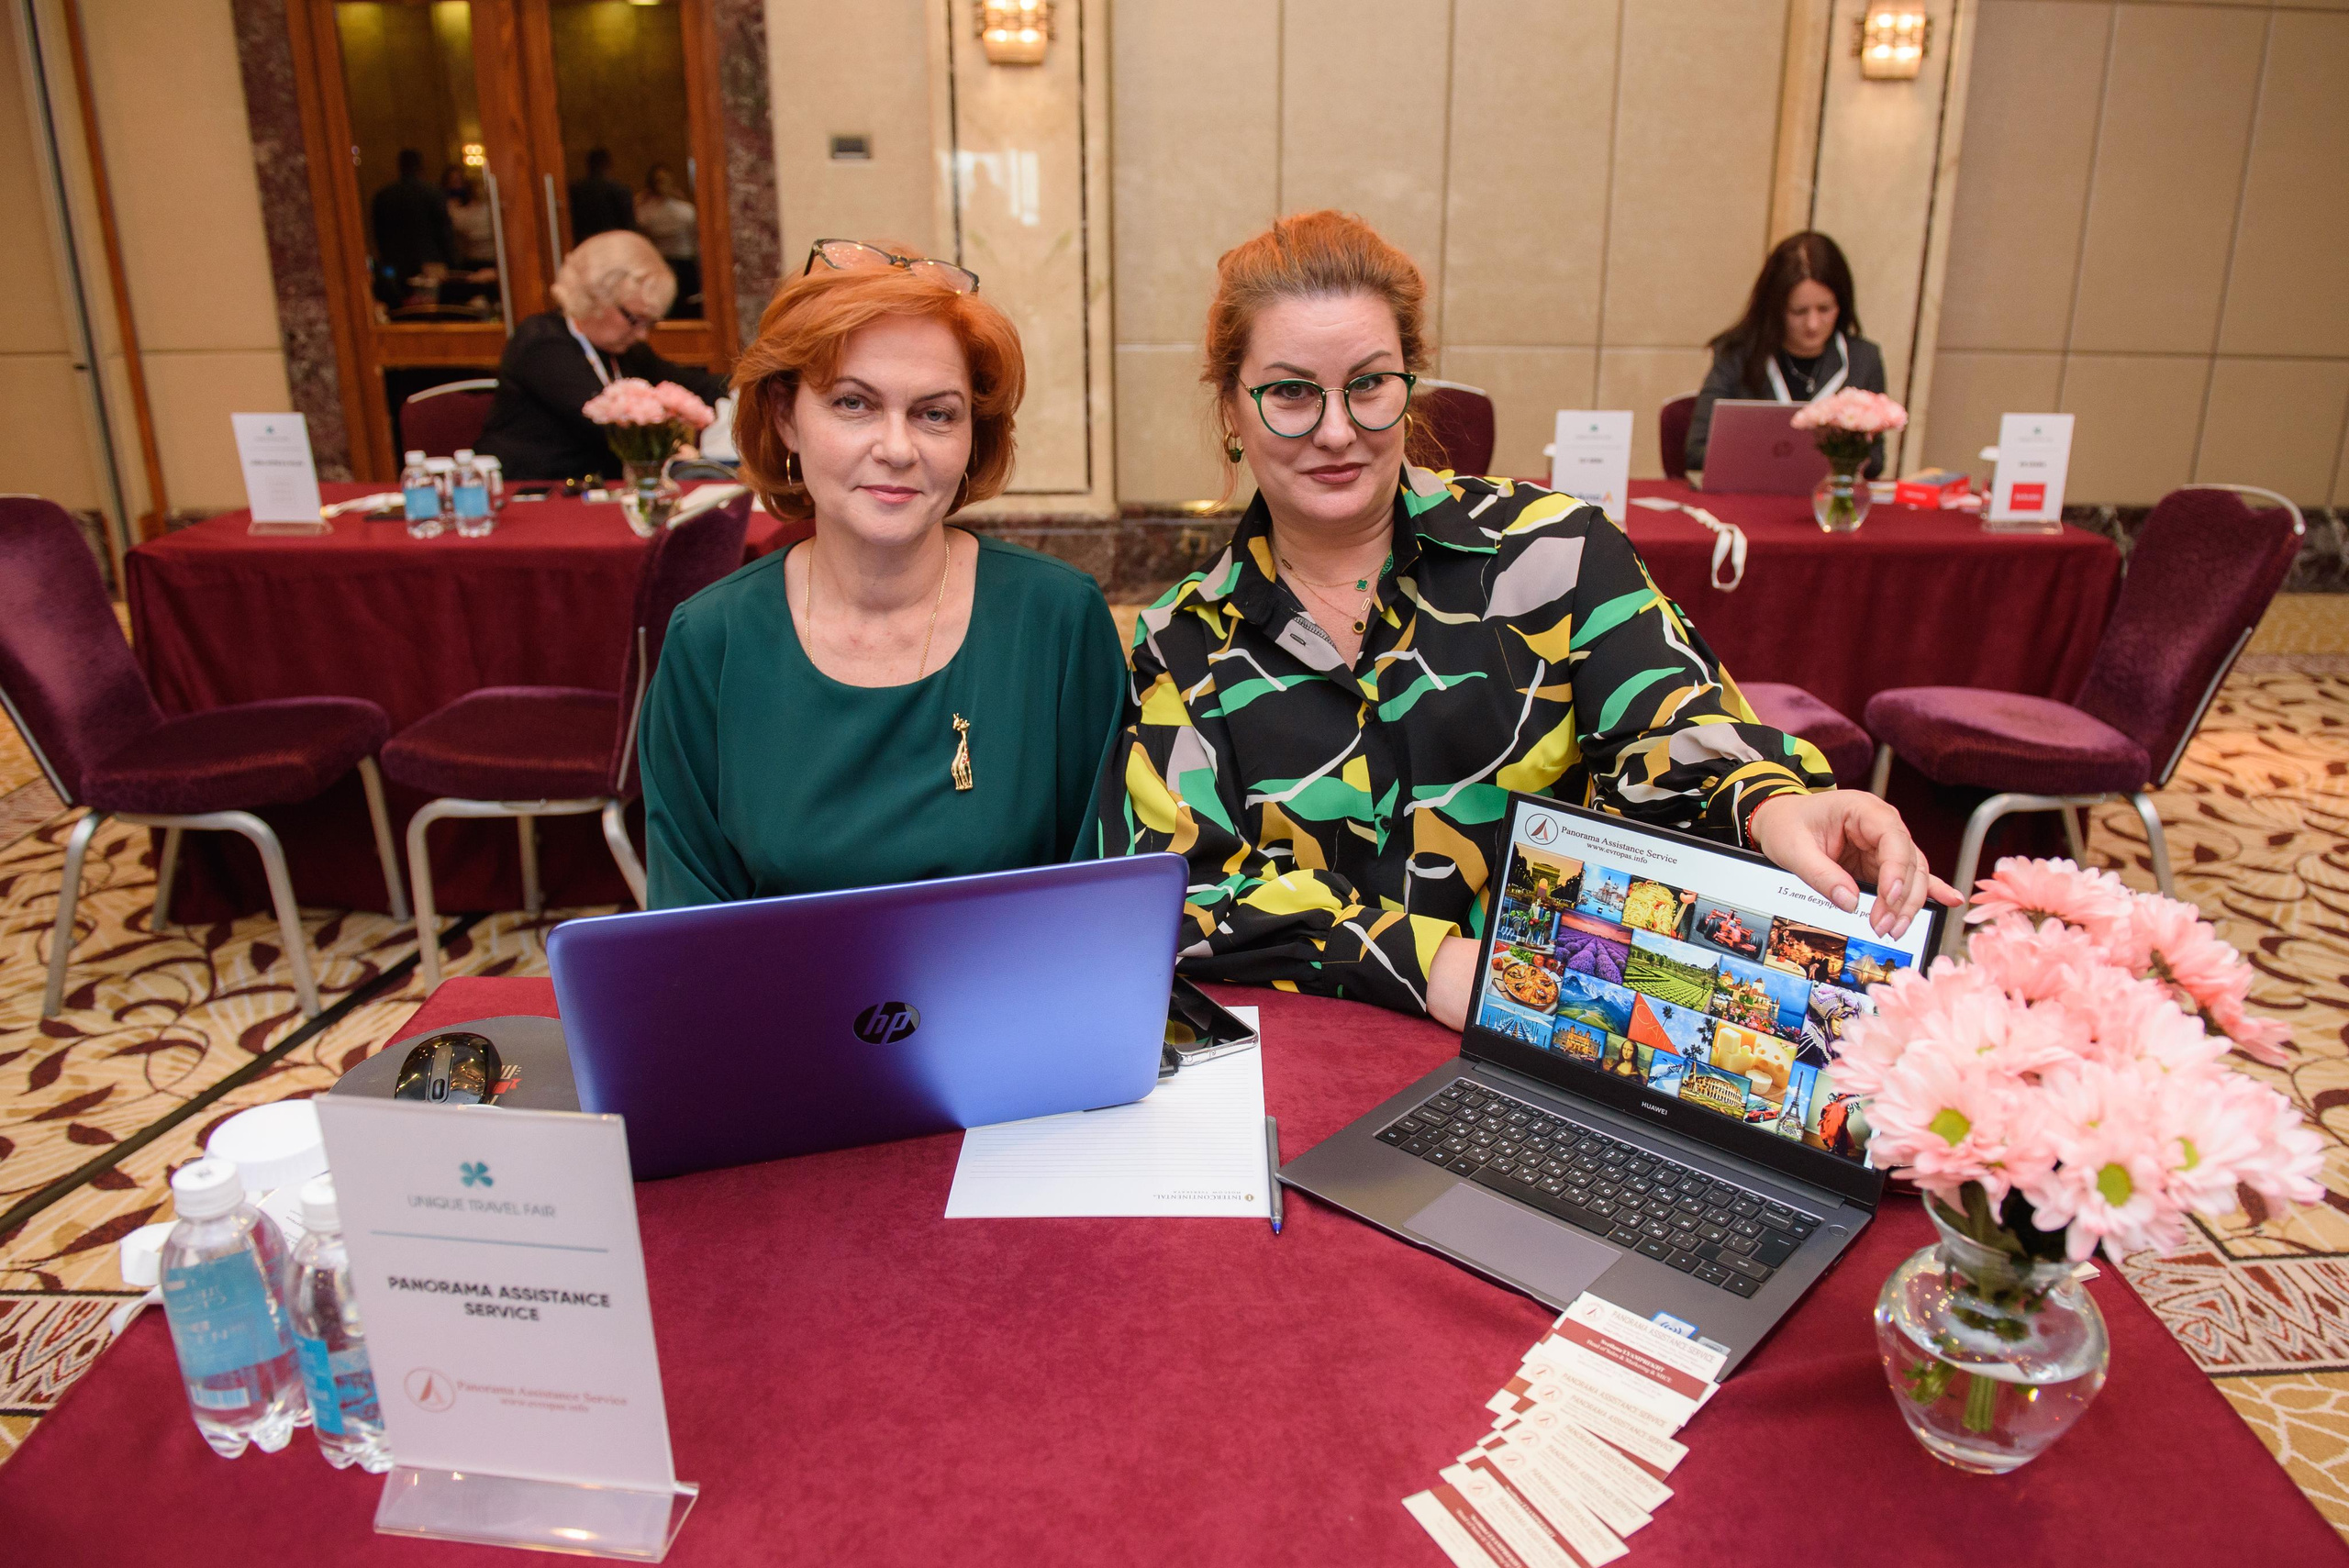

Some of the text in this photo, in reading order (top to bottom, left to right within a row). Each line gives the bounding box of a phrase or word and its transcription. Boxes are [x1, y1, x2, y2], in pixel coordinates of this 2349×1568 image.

[1561, 826, 1678, 864] Panorama Assistance Service
[1586, 842, 1648, 864] www.evropas.info
[1777, 886, 1789, 895] 15
[1789, 893, 1807, 901] лет
[863, 1002, 912, 1044] hp
[1642, 1101, 1667, 1116] HUAWEI
[407, 1195, 556, 1218] UNIQUE TRAVEL FAIR
[387, 1275, 611, 1309] PANORAMA ASSISTANCE
[464, 1302, 540, 1321] SERVICE
[1611, 1310, 1648, 1331] PANORAMA
[1650, 1327, 1687, 1350] ASSISTANCE
[1687, 1343, 1717, 1363] SERVICE
[1563, 1373, 1598, 1394] PANORAMA
[1599, 1392, 1638, 1413] ASSISTANCE
[1640, 1409, 1667, 1428] SERVICE
[1571, 1395, 1675, 1452] PANORAMA ASSISTANCE SERVICE
